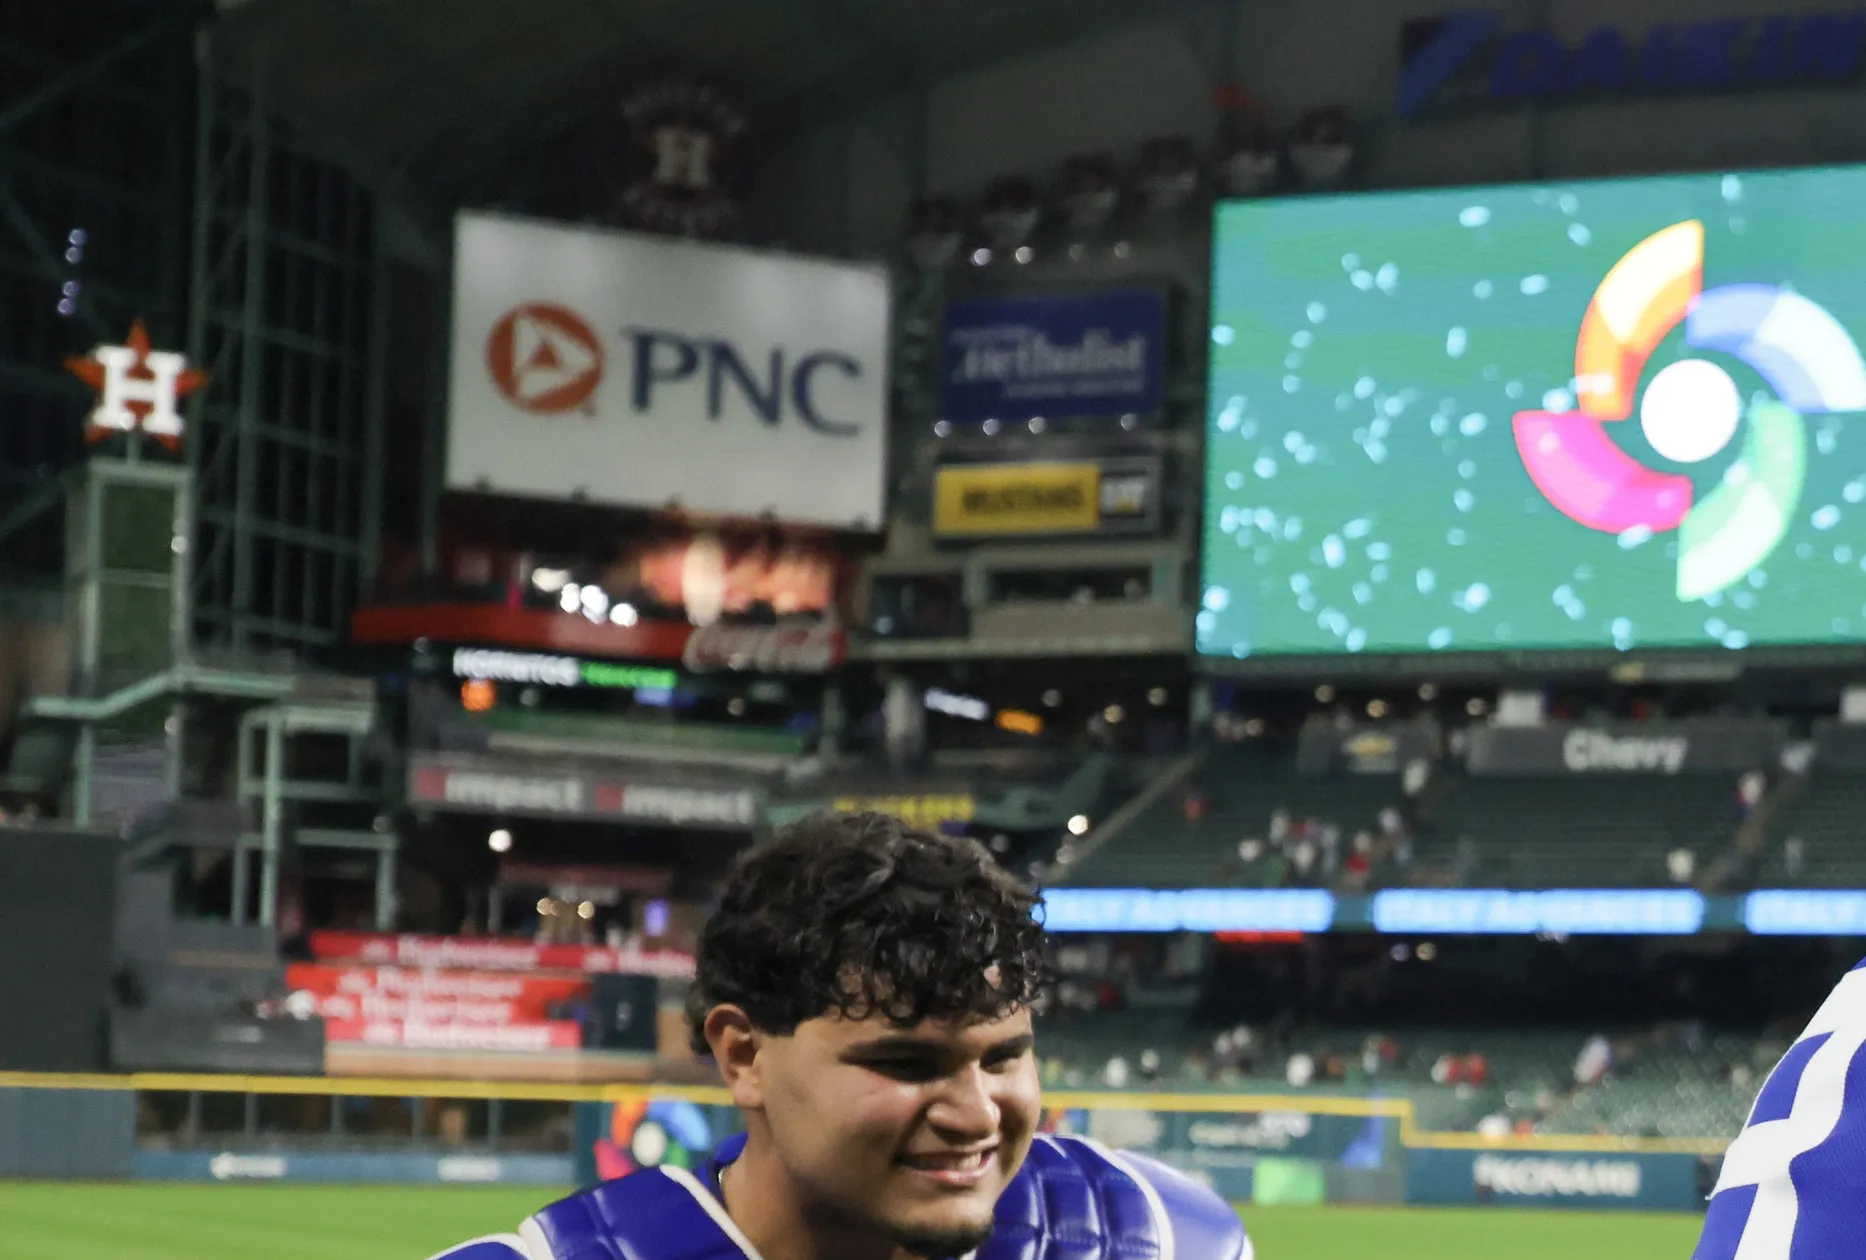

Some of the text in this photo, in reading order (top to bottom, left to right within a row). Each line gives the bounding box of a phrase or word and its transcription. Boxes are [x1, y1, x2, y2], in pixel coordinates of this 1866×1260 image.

[91, 344, 187, 433] H
[625, 327, 861, 436] PNC
[1563, 727, 1689, 774] Chevy
[624, 786, 754, 825] impact
